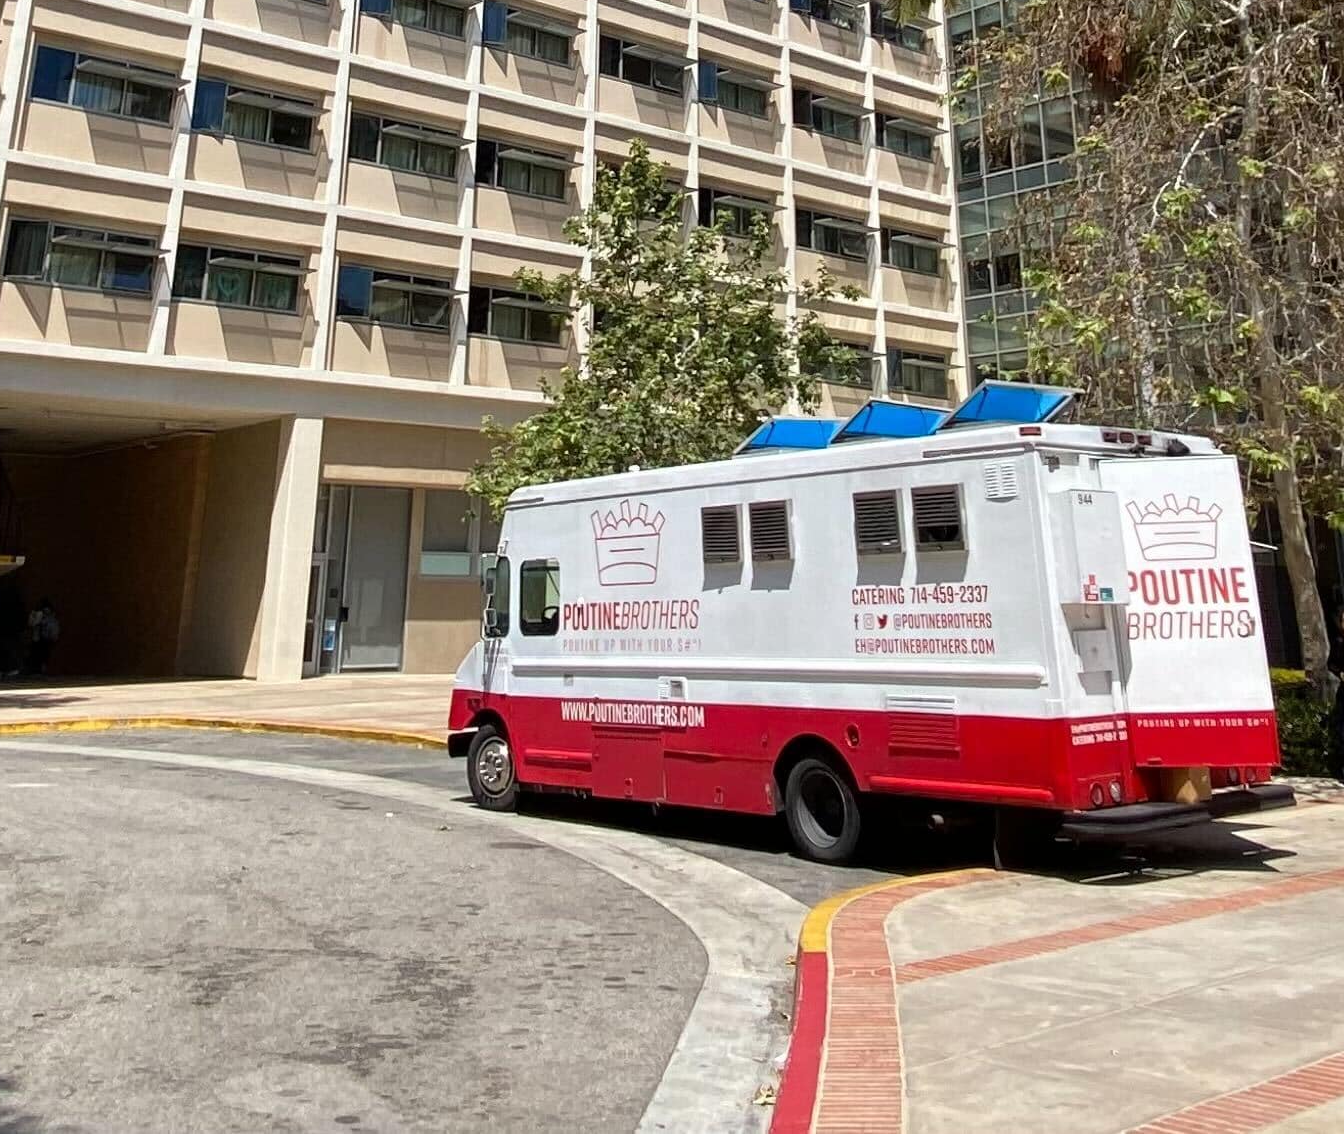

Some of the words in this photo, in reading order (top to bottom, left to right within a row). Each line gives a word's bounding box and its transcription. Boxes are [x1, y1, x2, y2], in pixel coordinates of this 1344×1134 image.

[1077, 493, 1093, 505] 944
[851, 587, 905, 605] CATERING
[910, 585, 988, 604] 714-459-2337
[1127, 567, 1250, 605] POUTINE
[563, 599, 700, 631] POUTINEBROTHERS
[893, 612, 993, 631] @POUTINEBROTHERS
[1128, 609, 1251, 640] BROTHERS
[605, 638, 616, 652] UP
[619, 638, 643, 652] WITH
[648, 638, 673, 652] YOUR
[855, 638, 995, 655] EH@POUTINEBROTHERS.COM
[560, 701, 705, 728] WWW.POUTINEBROTHERS.COM
[1220, 717, 1244, 727] YOUR
